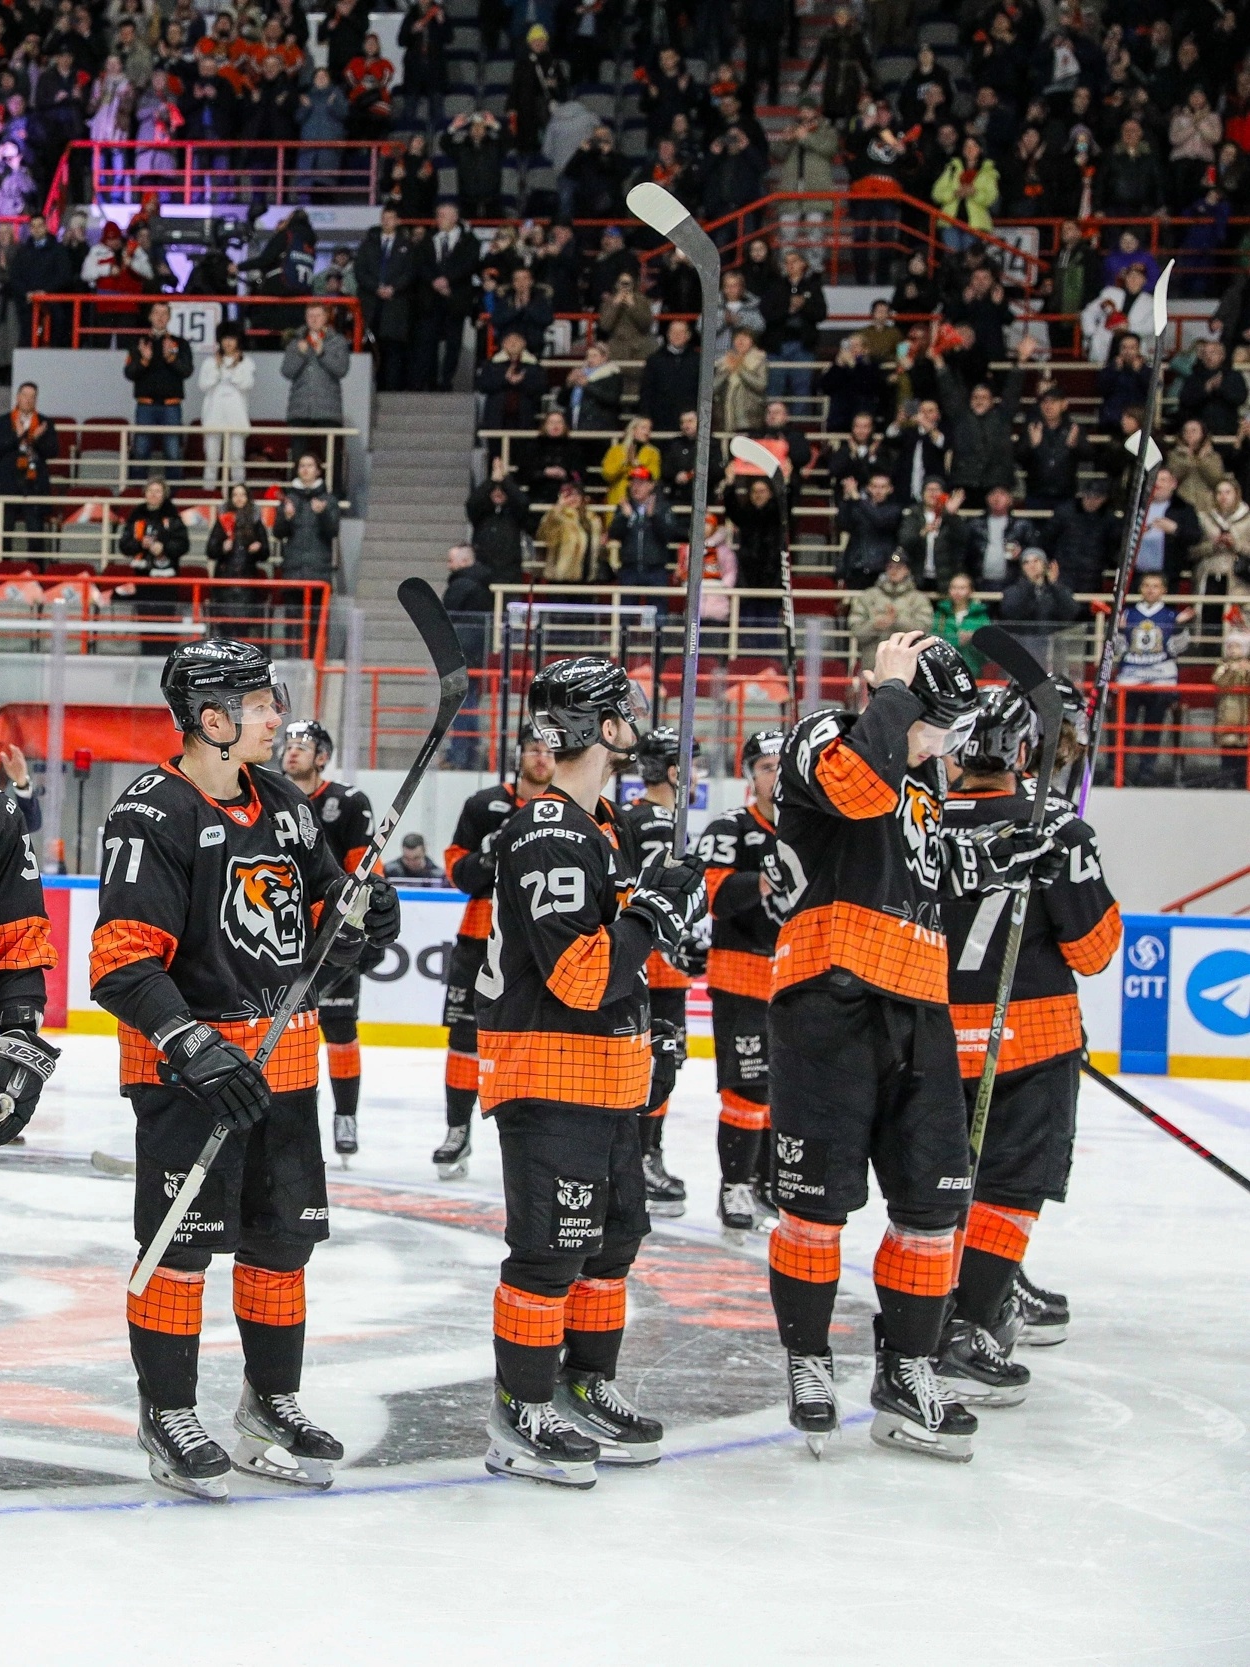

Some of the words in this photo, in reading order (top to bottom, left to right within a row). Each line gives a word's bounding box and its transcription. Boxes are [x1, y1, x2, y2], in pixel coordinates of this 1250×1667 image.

[177, 312, 205, 342] 15
[511, 828, 587, 852] OLIMPBET
[698, 834, 738, 864] 93
[104, 837, 144, 885] 71
[336, 805, 400, 915] CCM
[520, 867, 585, 921] 29
[265, 1010, 288, 1045] TRIGGER
[973, 1066, 995, 1135] TACKS
[560, 1218, 591, 1229] ЦЕНТР
[558, 1238, 583, 1248] ТИГР
